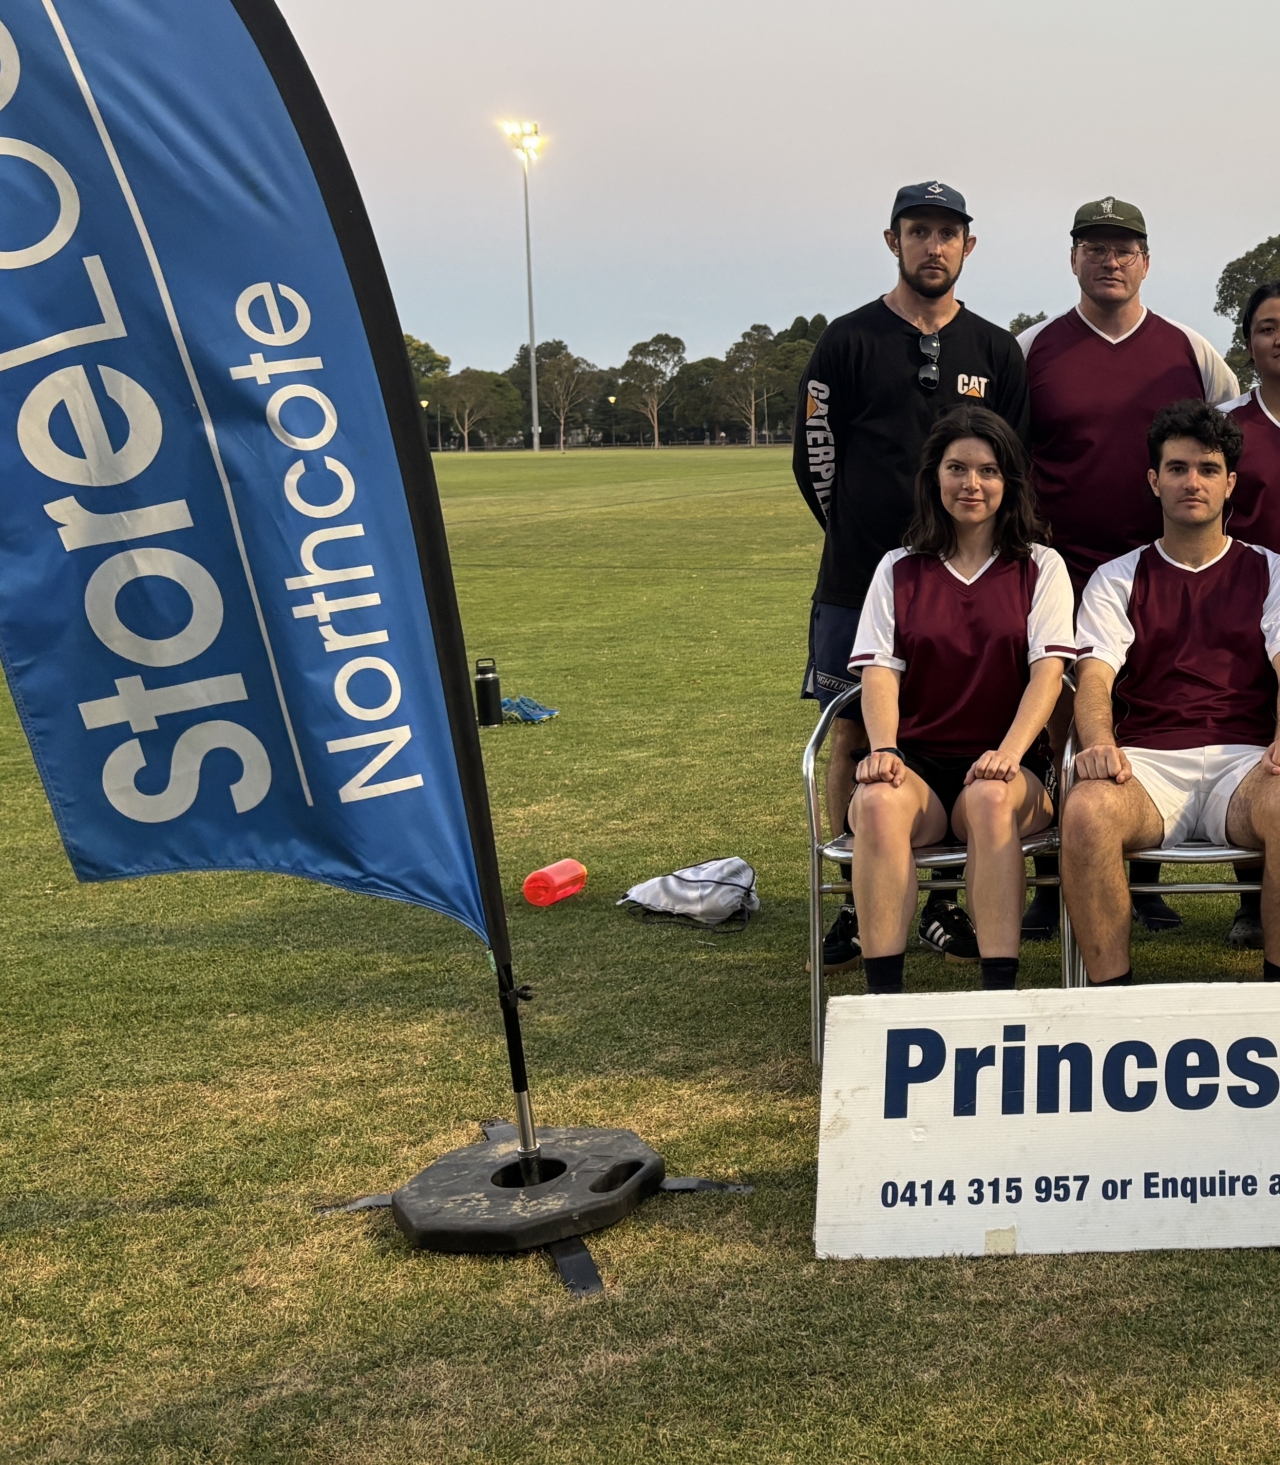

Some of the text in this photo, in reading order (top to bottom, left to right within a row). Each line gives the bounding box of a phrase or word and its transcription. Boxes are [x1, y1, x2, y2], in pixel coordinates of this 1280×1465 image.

[0, 19, 271, 824] StoreLo
[957, 373, 988, 398] CAT
[229, 281, 424, 804] Northcote
[883, 1024, 1280, 1119] Princes
[880, 1179, 956, 1208] 0414
[967, 1177, 1023, 1206] 315
[1034, 1174, 1090, 1203] 957
[1101, 1178, 1133, 1201] or
[1143, 1169, 1258, 1204] Enquire
